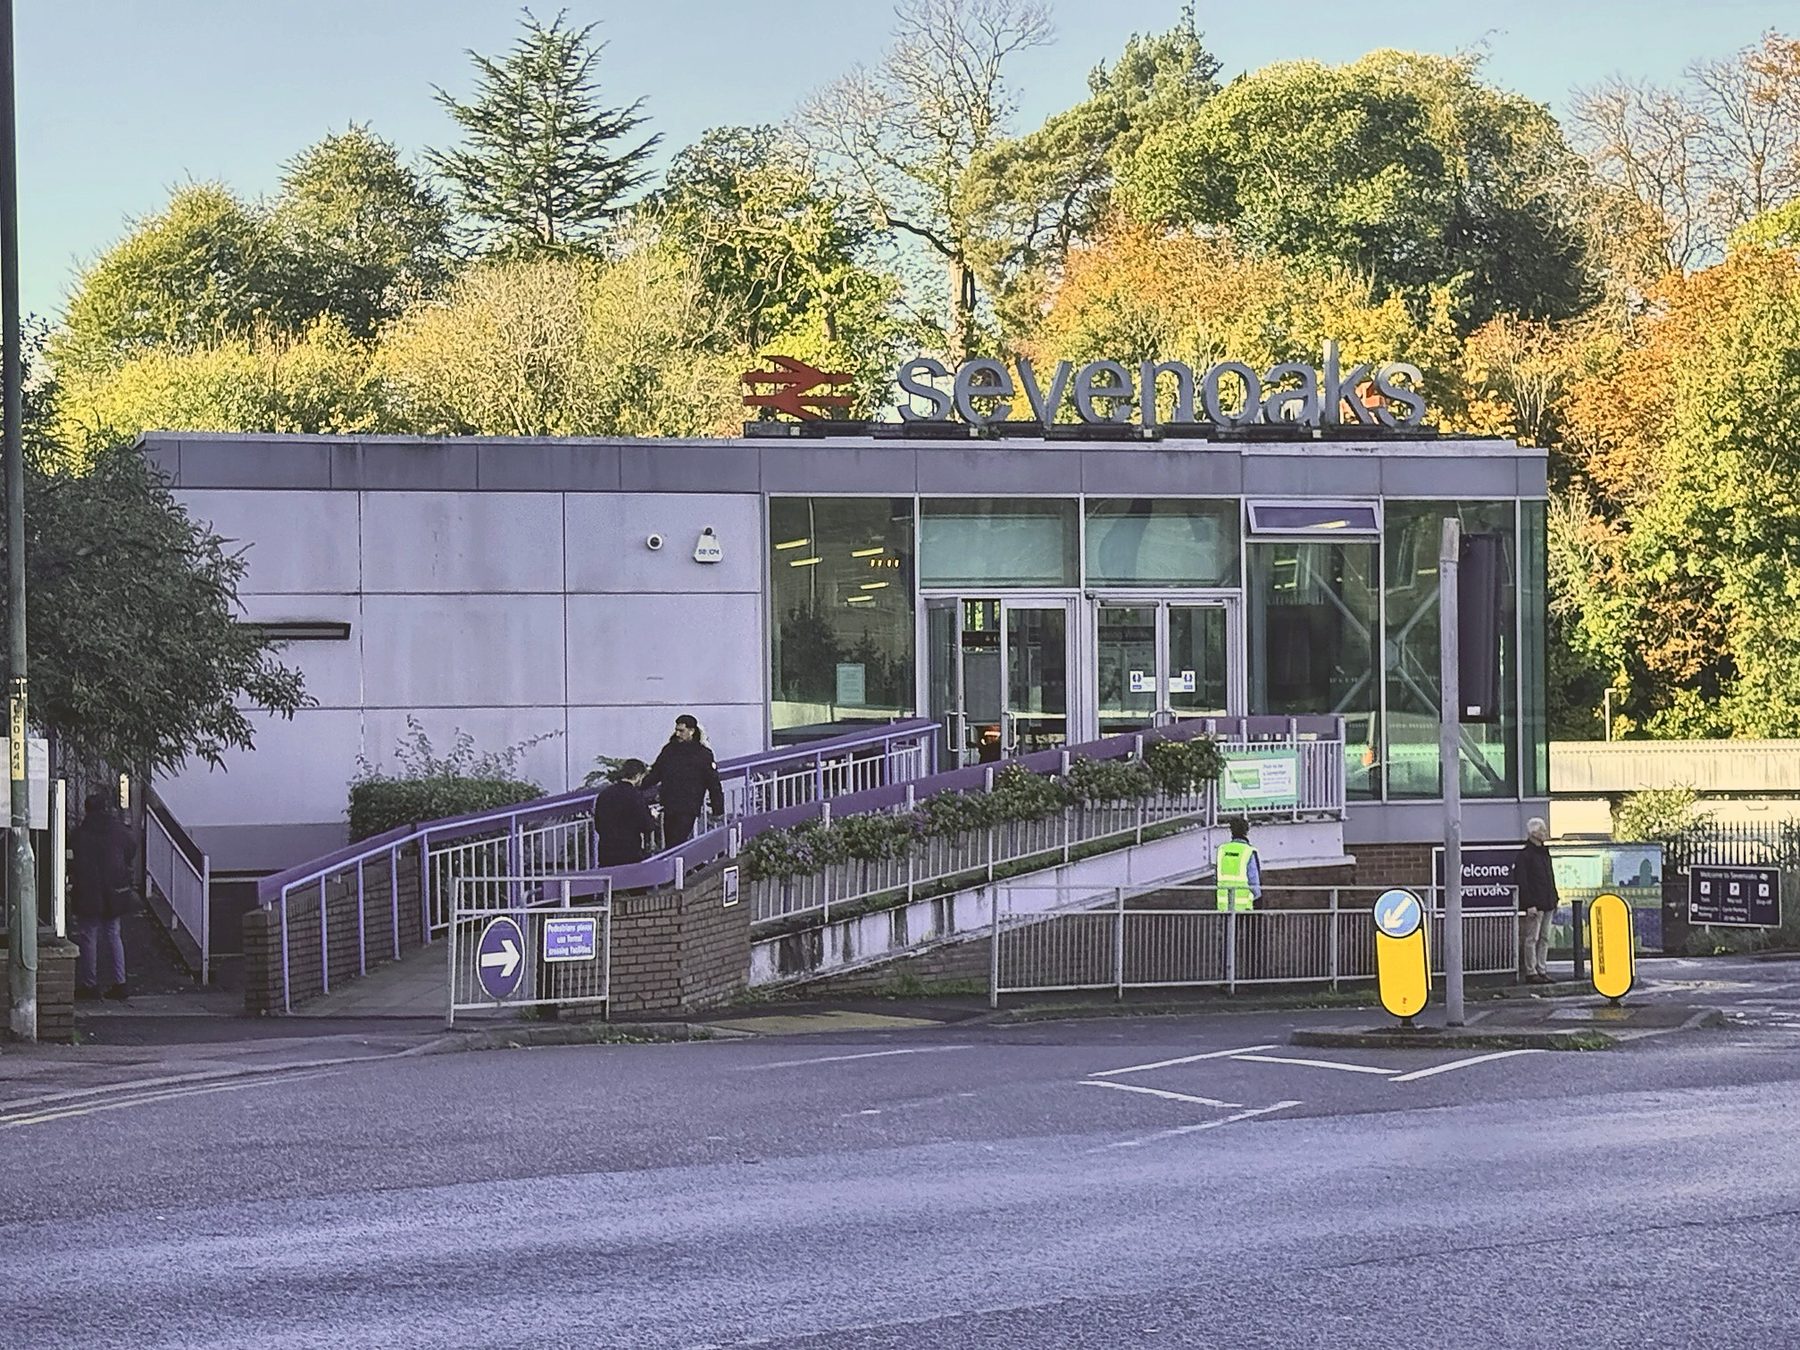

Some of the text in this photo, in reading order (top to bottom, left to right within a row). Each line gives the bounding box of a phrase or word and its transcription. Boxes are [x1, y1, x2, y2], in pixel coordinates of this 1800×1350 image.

[898, 340, 1425, 427] sevenoaks
[1460, 864, 1508, 876] elcome
[1460, 883, 1510, 896] venoaks
